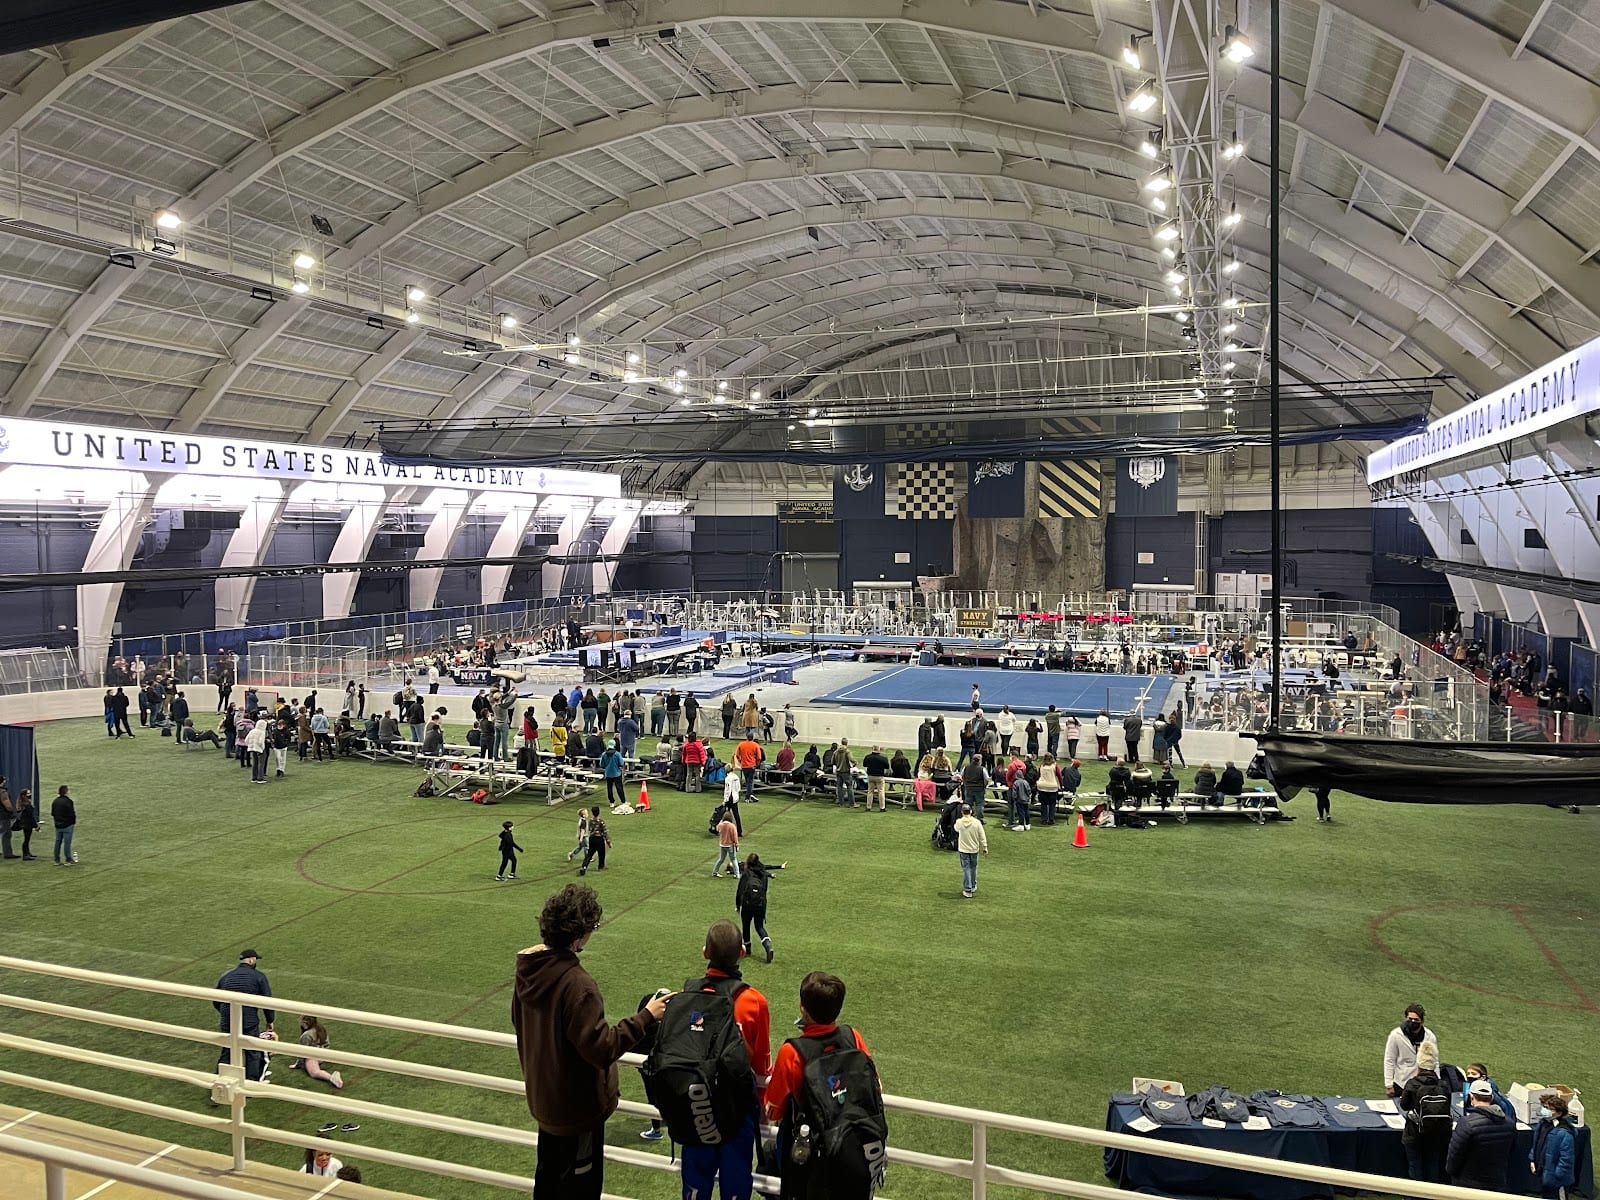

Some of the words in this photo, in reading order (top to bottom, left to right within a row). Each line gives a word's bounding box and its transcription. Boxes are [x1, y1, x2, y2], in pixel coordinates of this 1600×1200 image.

[1396, 437, 1420, 468] UNITED
[1422, 422, 1453, 458] STATES
[1457, 404, 1493, 446] NAVAL
[1499, 359, 1580, 431] ACADEMY
[52, 430, 201, 465] UNITED
[222, 445, 333, 474] STATES
[346, 456, 422, 479] NAVAL
[433, 466, 525, 487] ACADEMY
[962, 611, 988, 620] NAVY
[1008, 659, 1035, 668] NAVY
[460, 671, 488, 680] NAVY
[1280, 687, 1312, 696] NAVY
